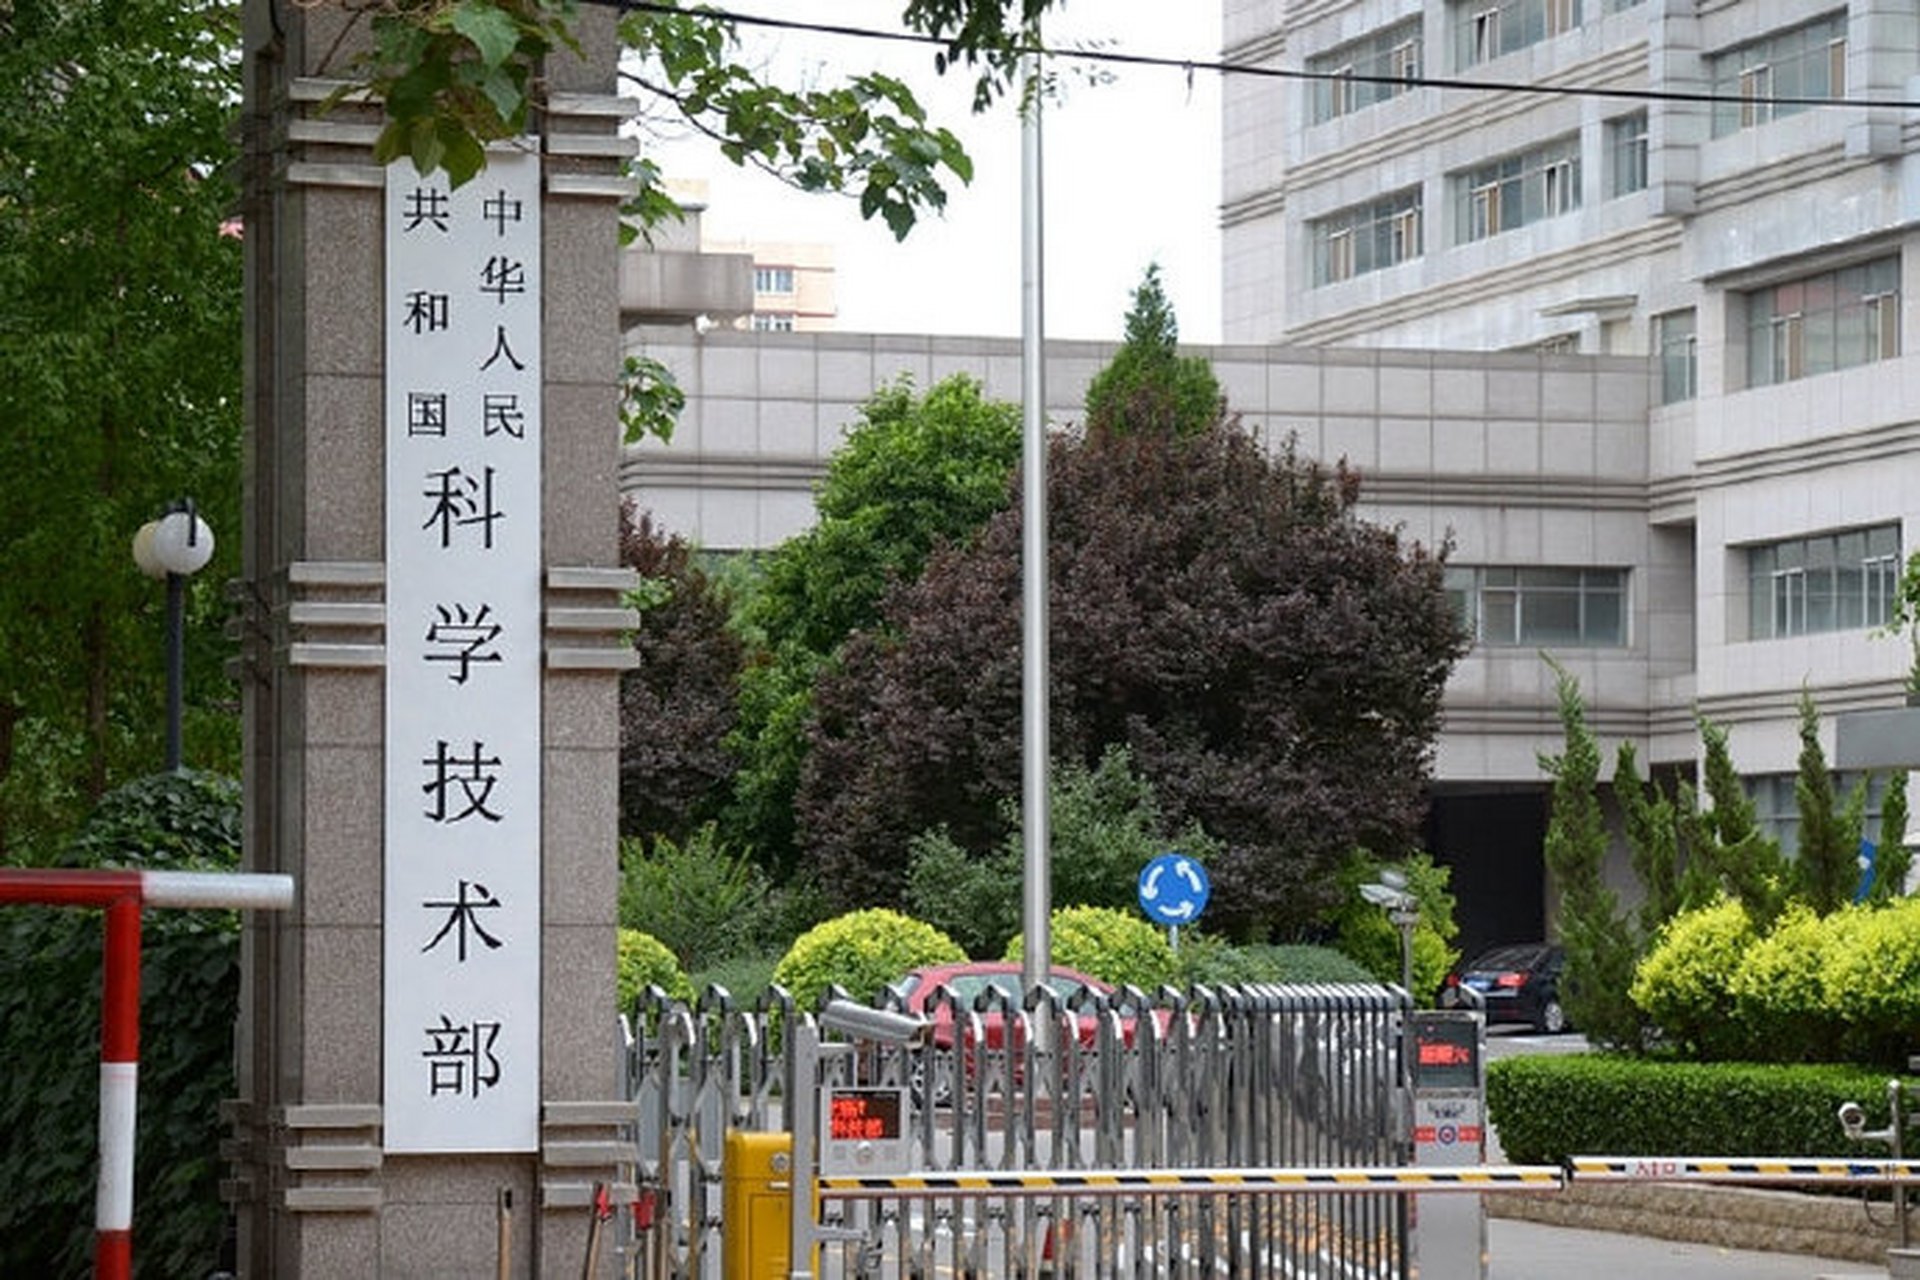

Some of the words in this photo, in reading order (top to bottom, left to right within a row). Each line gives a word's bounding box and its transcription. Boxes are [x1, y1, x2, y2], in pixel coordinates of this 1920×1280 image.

[403, 187, 449, 438] 共和国
[479, 189, 525, 439] 中华人民
[421, 466, 504, 1099] 科学技术部
